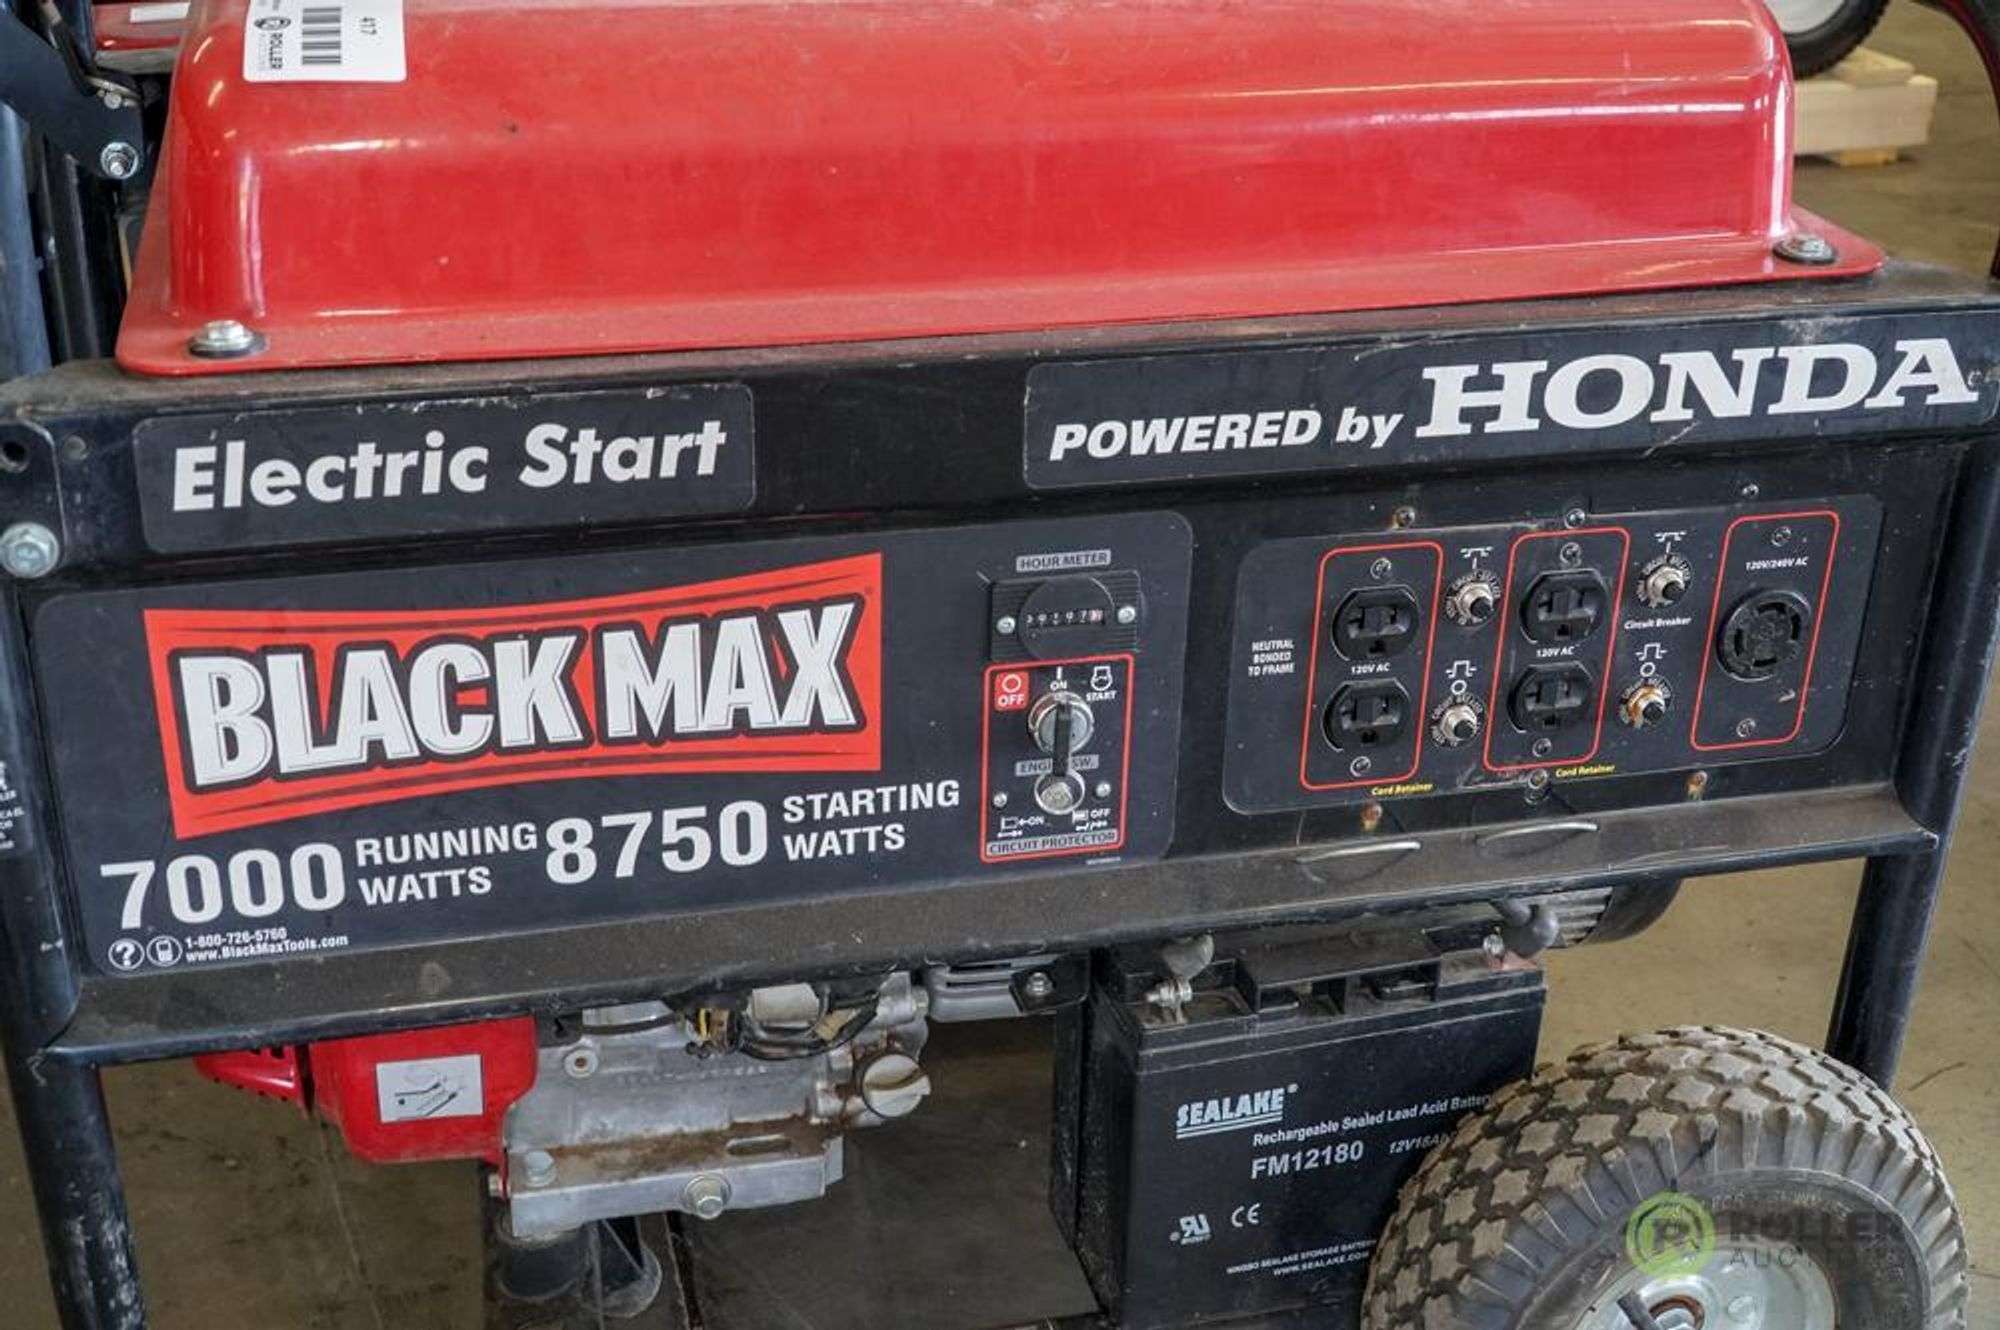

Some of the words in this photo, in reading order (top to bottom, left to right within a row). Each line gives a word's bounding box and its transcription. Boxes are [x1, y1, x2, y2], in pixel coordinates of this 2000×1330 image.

[269, 33, 283, 70] ROLLER
[1049, 409, 1322, 461] POWERED
[1335, 406, 1405, 449] by
[1415, 338, 1979, 438] HONDA
[173, 429, 489, 512] Electric
[518, 420, 728, 488] Start
[1020, 556, 1061, 571] HOUR
[1063, 552, 1108, 567] METER
[1795, 556, 1809, 566] AC
[1624, 618, 1655, 630] Circuit
[1656, 616, 1692, 628] Breaker
[1252, 640, 1295, 651] NEUTRAL
[1536, 647, 1561, 658] 120V
[1560, 645, 1575, 656] AC
[1253, 651, 1292, 664] BONDED
[1351, 664, 1376, 674] 120V
[1376, 662, 1391, 672] AC
[1247, 666, 1261, 677] TO
[1262, 662, 1295, 676] FRAME
[178, 634, 585, 786] BLACK
[601, 602, 859, 739] MAX
[1050, 680, 1068, 690] ON
[1086, 690, 1118, 702] START
[998, 693, 1026, 707] OFF
[1578, 764, 1616, 776] Retainer
[1395, 783, 1434, 794] Retainer
[782, 779, 961, 823] STARTING
[1029, 816, 1045, 826] ON
[1089, 808, 1112, 819] OFF
[355, 821, 539, 867] RUNNING
[545, 800, 769, 884] 8750
[783, 823, 906, 861] WATTS
[990, 840, 1039, 855] CIRCUIT
[1041, 831, 1116, 849] PROTECTOR
[100, 843, 347, 930] 7000
[357, 866, 493, 906] WATTS
[185, 934, 349, 964] www.BlackMaxTools.com
[1175, 1087, 1285, 1128] SEALAKE
[1252, 1120, 1341, 1147] Rechargeable
[1341, 1110, 1385, 1131] Sealed
[1387, 1104, 1418, 1123] Lead
[1419, 1096, 1449, 1117] Acid
[1250, 1139, 1365, 1180] FM12180
[1231, 1202, 1261, 1228] CE
[1261, 1253, 1300, 1268] SEALAKE
[1301, 1246, 1340, 1260] STORAGE
